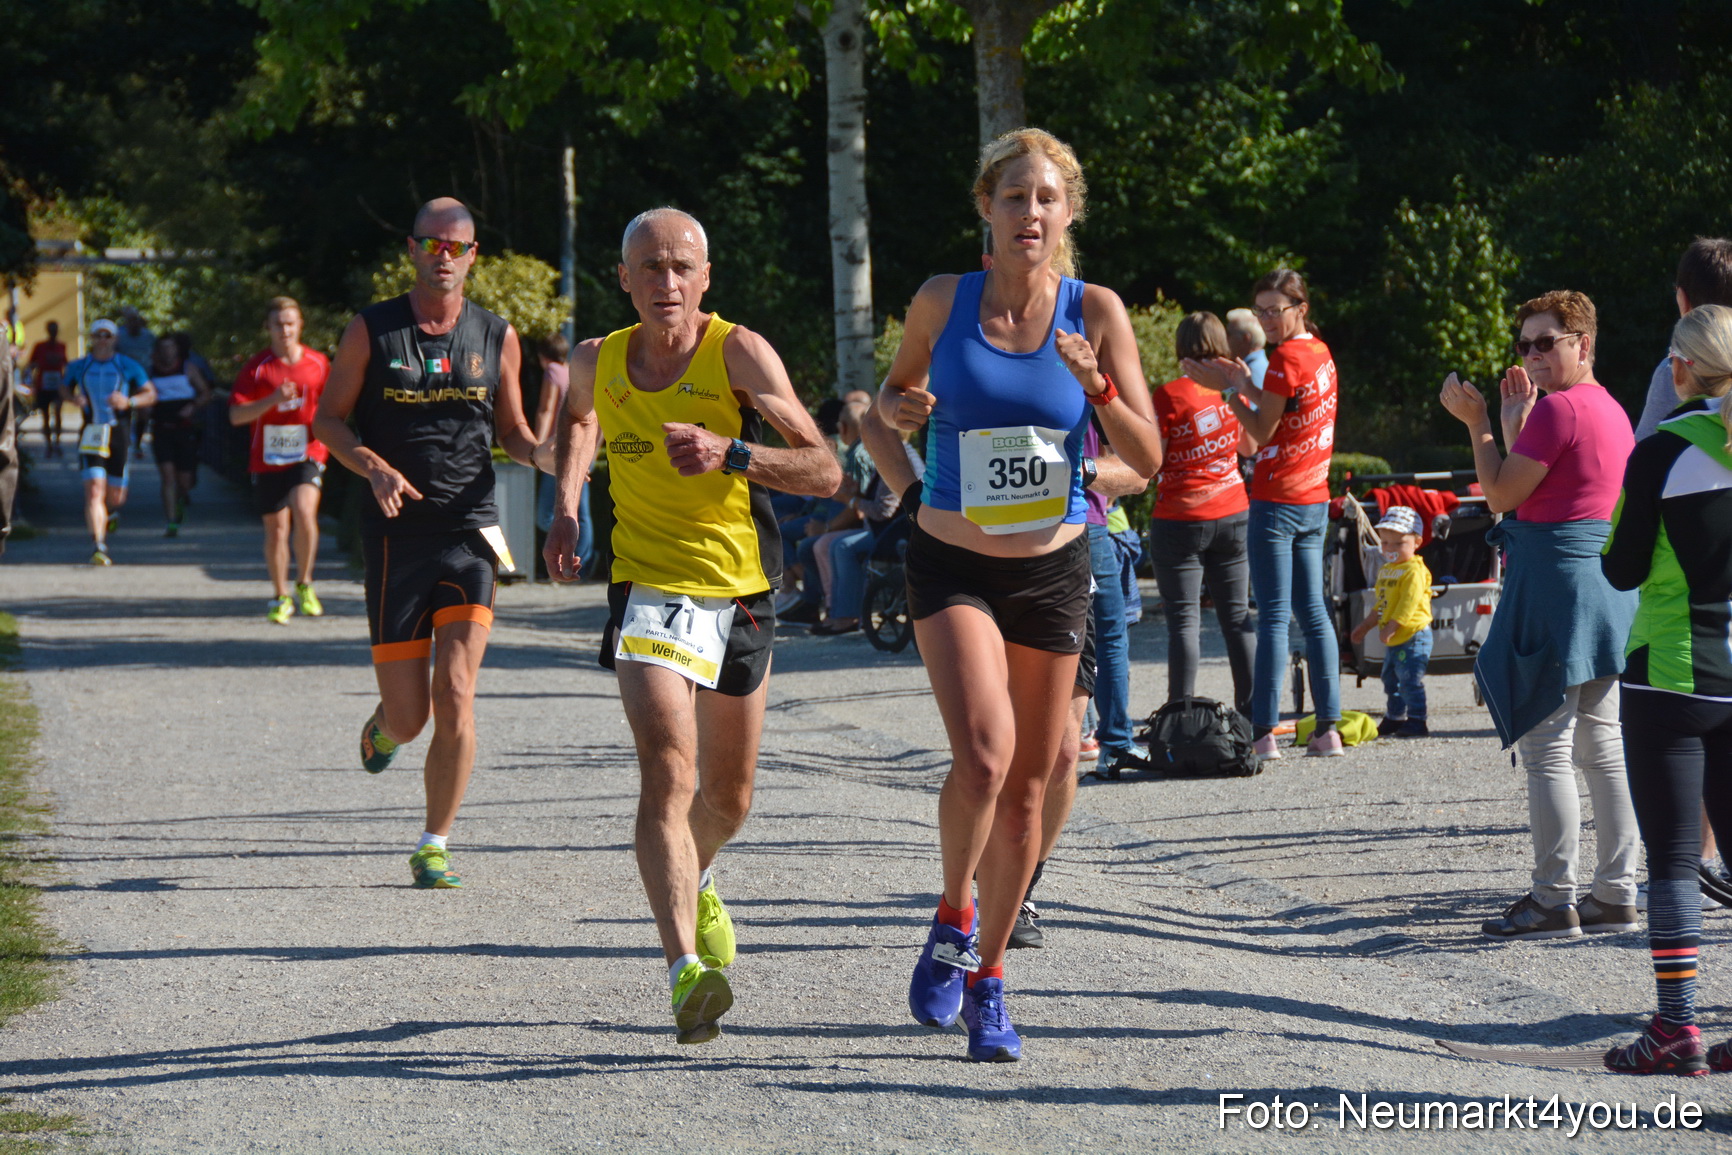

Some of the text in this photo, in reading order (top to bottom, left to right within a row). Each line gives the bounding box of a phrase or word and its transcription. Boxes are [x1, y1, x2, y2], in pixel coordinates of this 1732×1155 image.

[383, 387, 487, 403] PODIUMRACE
[988, 455, 1047, 490] 350
[986, 491, 1041, 502] PARTL Neumarkt
[663, 602, 695, 635] 71
[1431, 618, 1455, 631] ULE
[645, 628, 668, 640] PARTL
[651, 642, 693, 667] Werner
